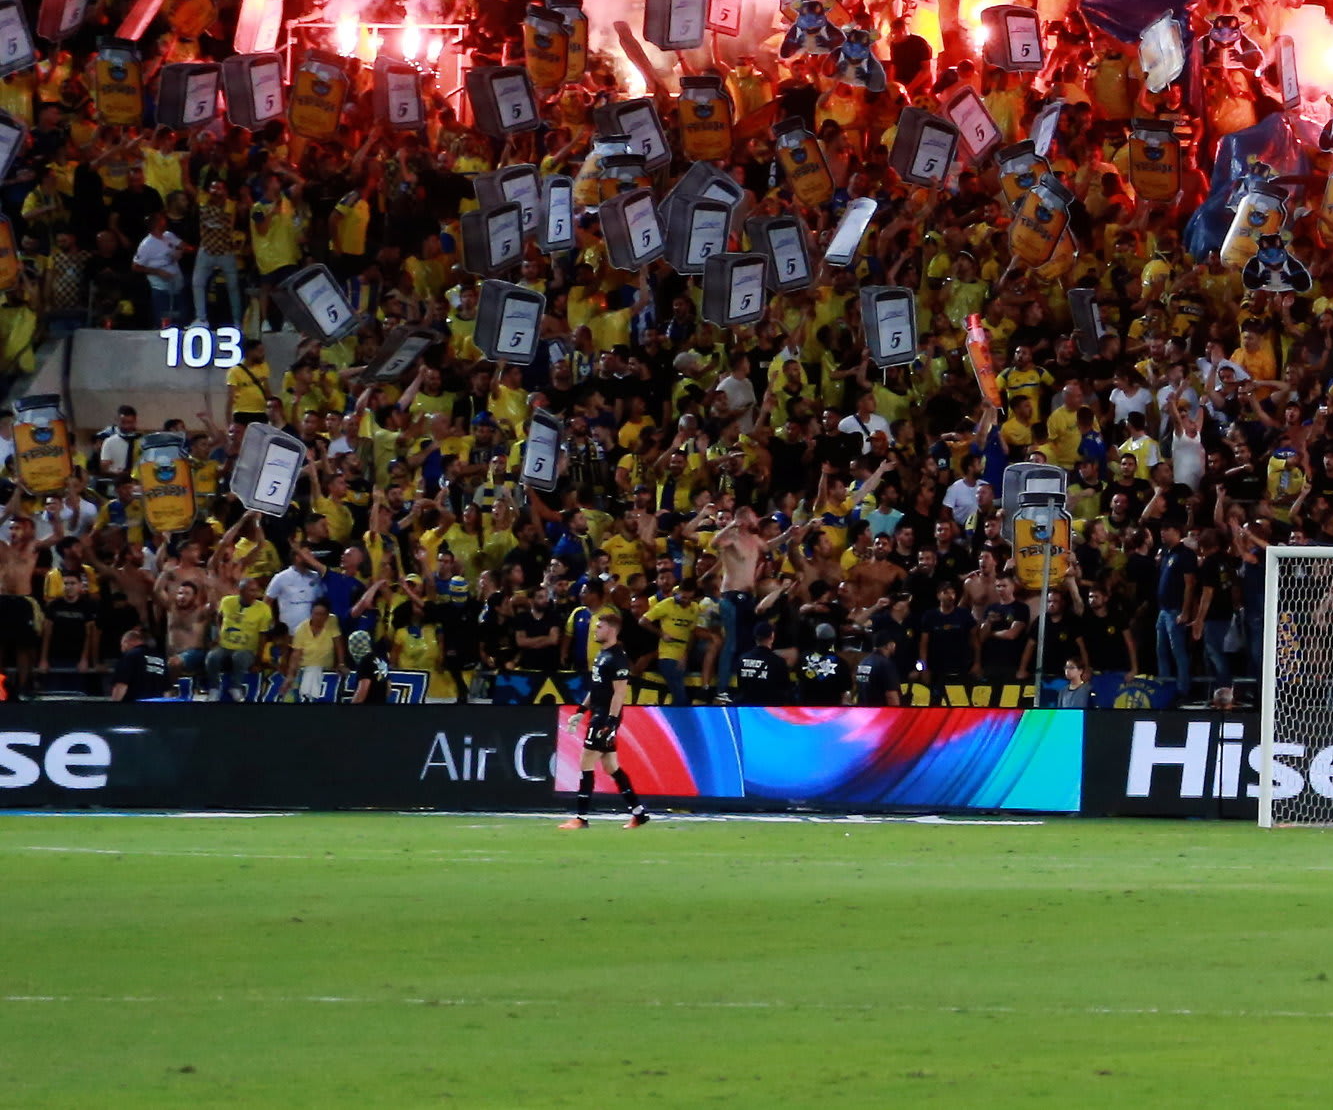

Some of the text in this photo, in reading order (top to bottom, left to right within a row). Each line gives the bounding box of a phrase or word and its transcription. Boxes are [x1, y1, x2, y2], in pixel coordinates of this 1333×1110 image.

[720, 9, 730, 20] 5
[8, 38, 17, 54] 5
[1020, 44, 1030, 57] 5
[194, 102, 206, 116] 5
[266, 95, 273, 111] 5
[397, 103, 408, 117] 5
[511, 104, 521, 119] 5
[975, 126, 984, 142] 5
[642, 139, 651, 153] 5
[923, 159, 937, 171] 5
[522, 207, 532, 224] 5
[556, 220, 563, 235] 5
[642, 229, 650, 247] 5
[501, 240, 512, 256] 5
[700, 243, 713, 258] 5
[786, 259, 796, 275] 5
[740, 294, 752, 310] 5
[327, 304, 338, 323] 5
[510, 332, 525, 347] 5
[891, 332, 902, 348] 5
[160, 327, 242, 368] 103
[533, 458, 546, 472] 5
[267, 481, 281, 496] 5
[420, 731, 556, 782] Air C
